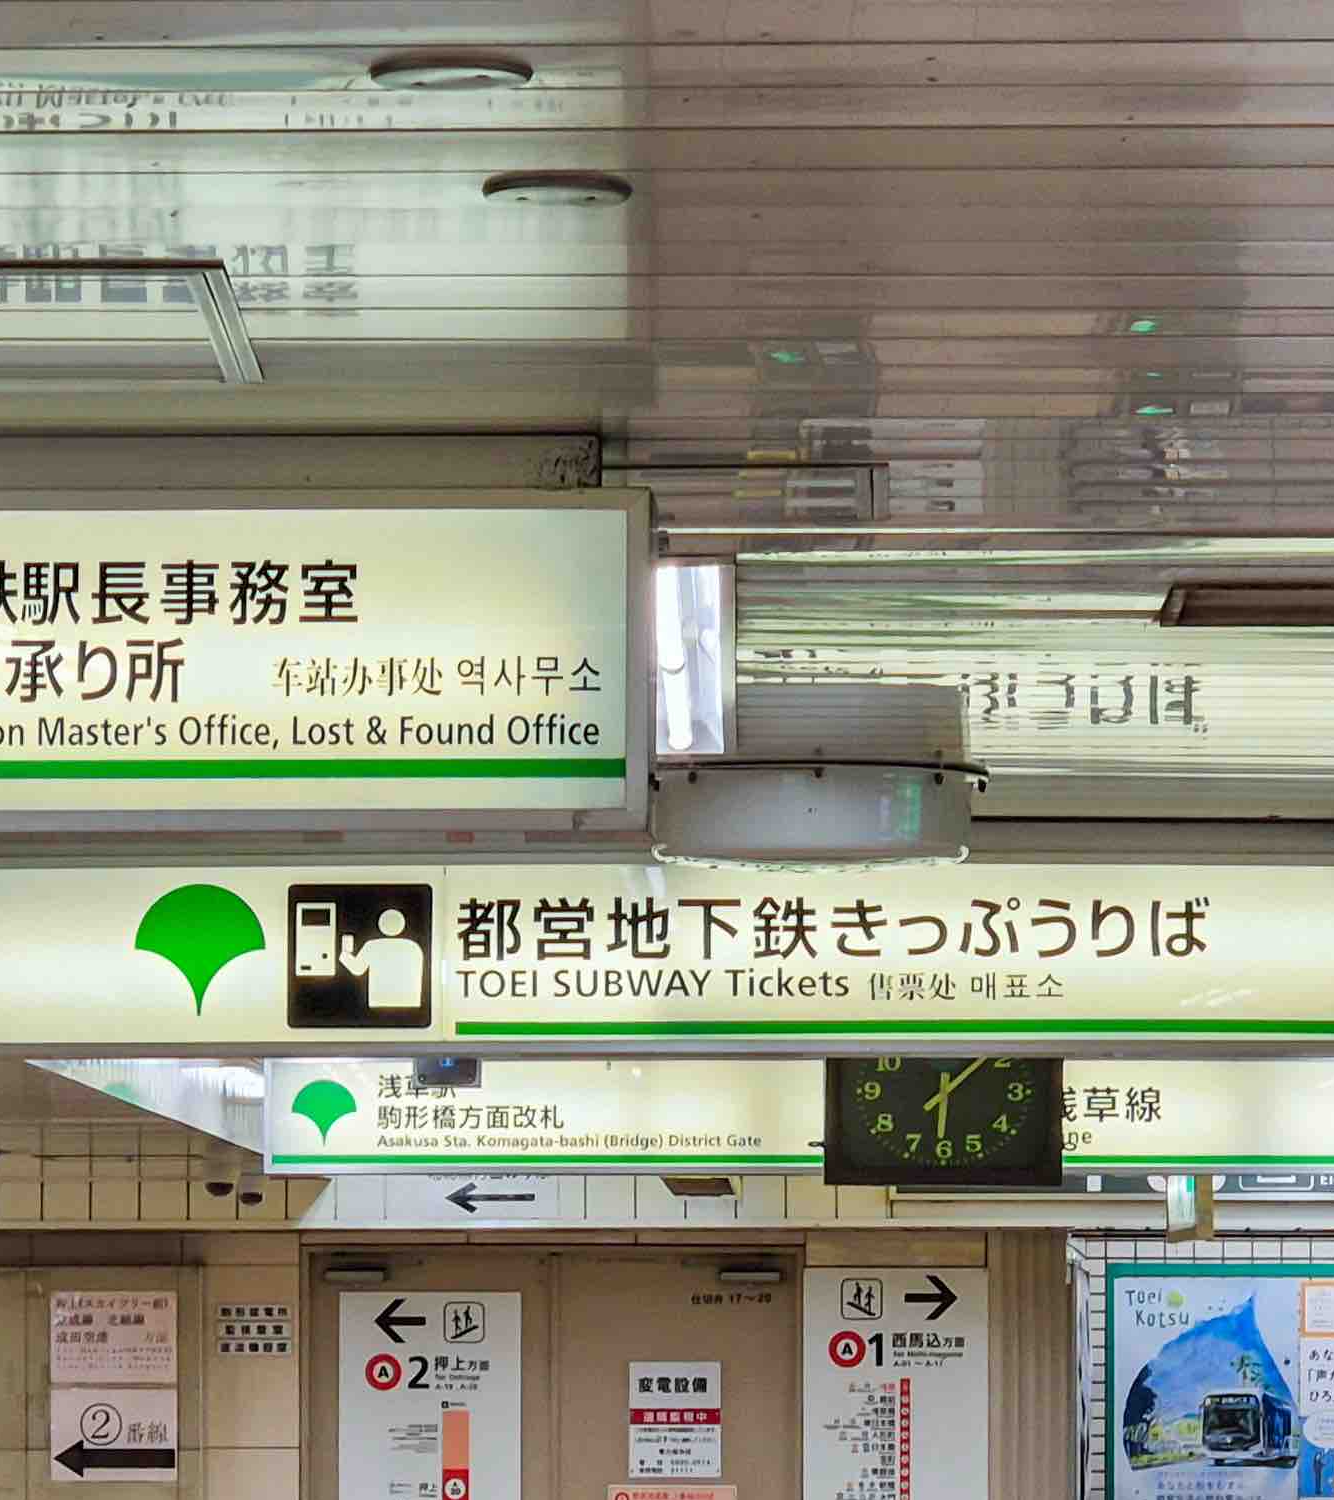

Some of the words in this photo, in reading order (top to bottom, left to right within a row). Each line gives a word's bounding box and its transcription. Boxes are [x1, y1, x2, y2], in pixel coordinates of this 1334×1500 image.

[271, 655, 443, 697] 车站办事处
[456, 655, 602, 697] 역사무소
[37, 715, 167, 747] Master's
[179, 714, 280, 752] Office,
[291, 715, 355, 746] Lost
[366, 714, 388, 746] &
[399, 713, 494, 746] Found
[506, 713, 601, 746] Office
[456, 896, 1211, 961] 都営地下鉄きっぷうりば
[456, 969, 538, 998] TOEI
[553, 969, 712, 999] SUBWAY
[724, 967, 850, 999] Tickets
[970, 972, 1065, 1001] 매표소
[863, 1082, 882, 1101] 9
[1006, 1082, 1025, 1101] 3
[376, 1104, 565, 1131] 駒形橋方面改札
[877, 1113, 894, 1132] 8
[992, 1114, 1009, 1131] 4
[376, 1135, 438, 1149] Asakusa
[444, 1135, 471, 1148] Sta.
[476, 1134, 600, 1152] Komagata-bashi
[604, 1134, 664, 1152] (Bridge)
[668, 1135, 723, 1149] District
[727, 1135, 762, 1149] Gate
[906, 1133, 922, 1152] 7
[935, 1140, 953, 1159] 6
[966, 1134, 983, 1152] 5
[868, 1332, 884, 1367] 1
[407, 1355, 430, 1390] 2
[637, 1376, 708, 1394] 変電設備
